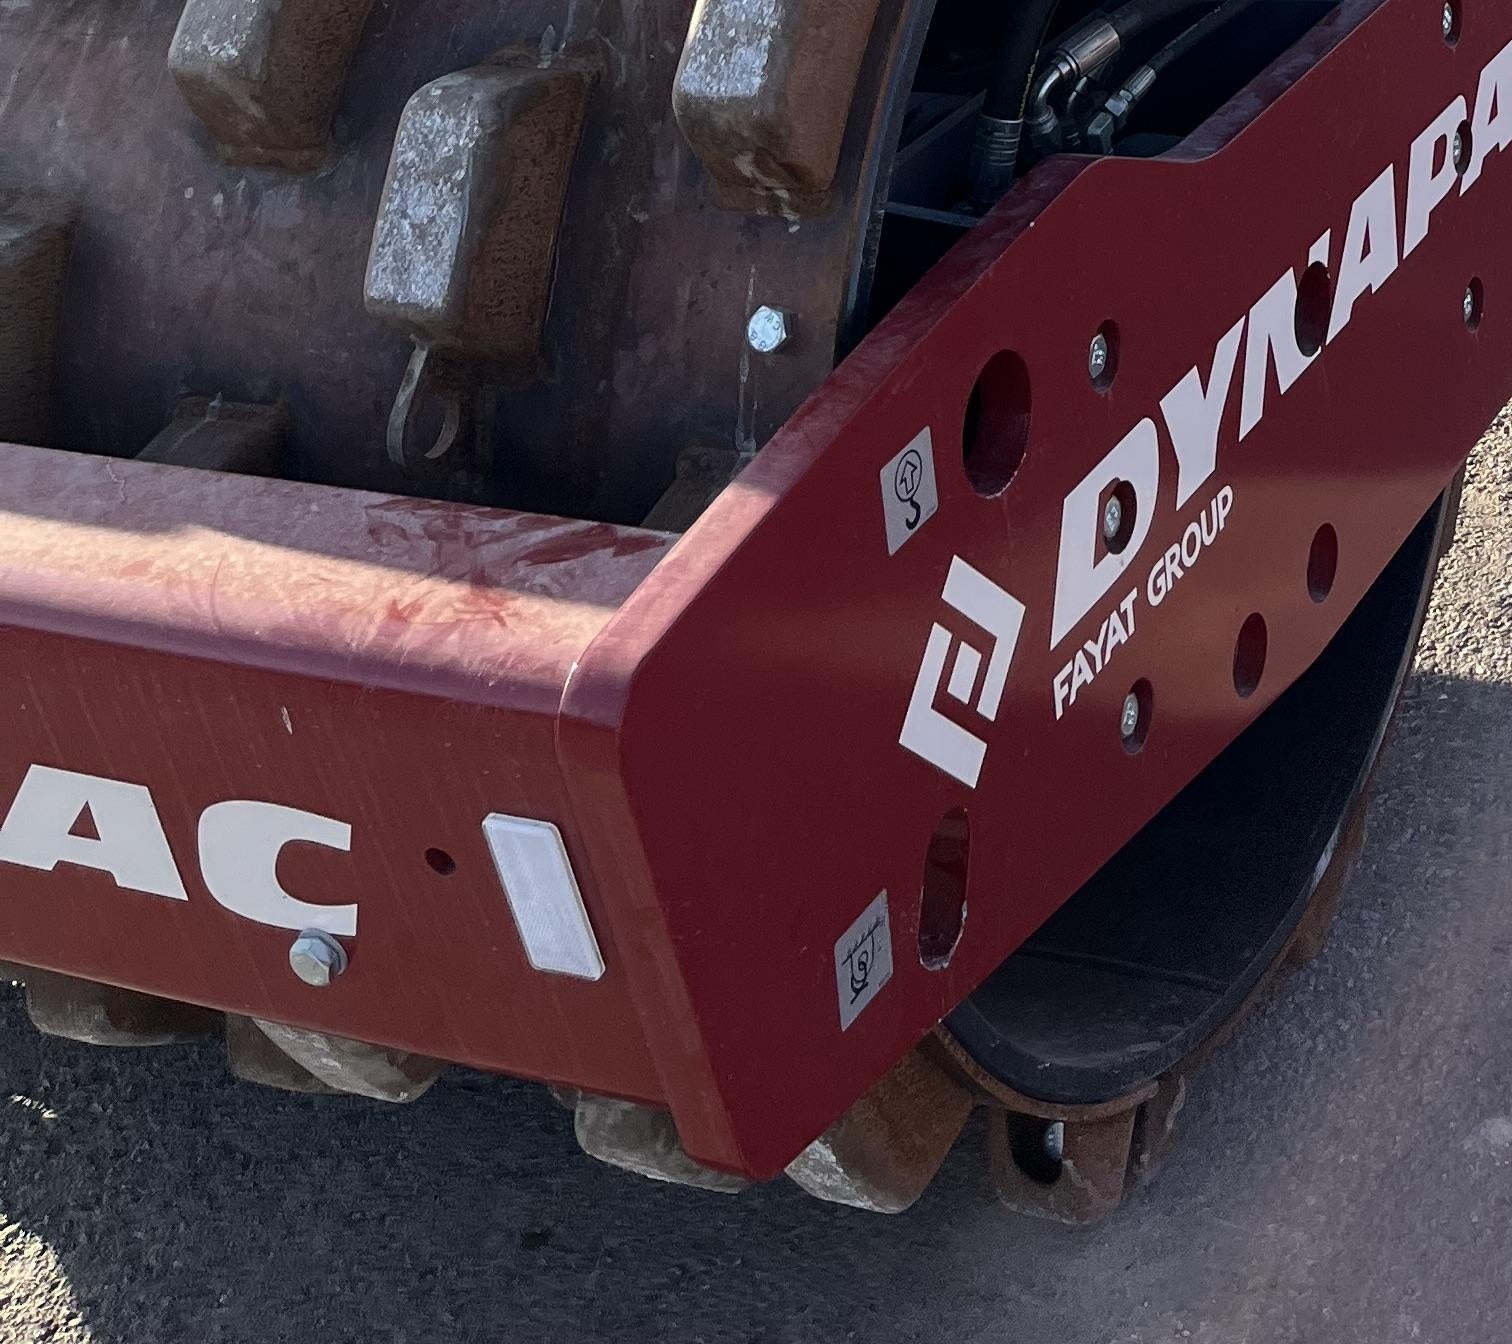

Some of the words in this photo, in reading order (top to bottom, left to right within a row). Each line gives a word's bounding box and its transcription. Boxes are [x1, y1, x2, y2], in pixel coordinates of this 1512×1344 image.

[1053, 587, 1138, 720] FAYAT
[1147, 484, 1234, 607] GROUP
[0, 763, 358, 937] AC
